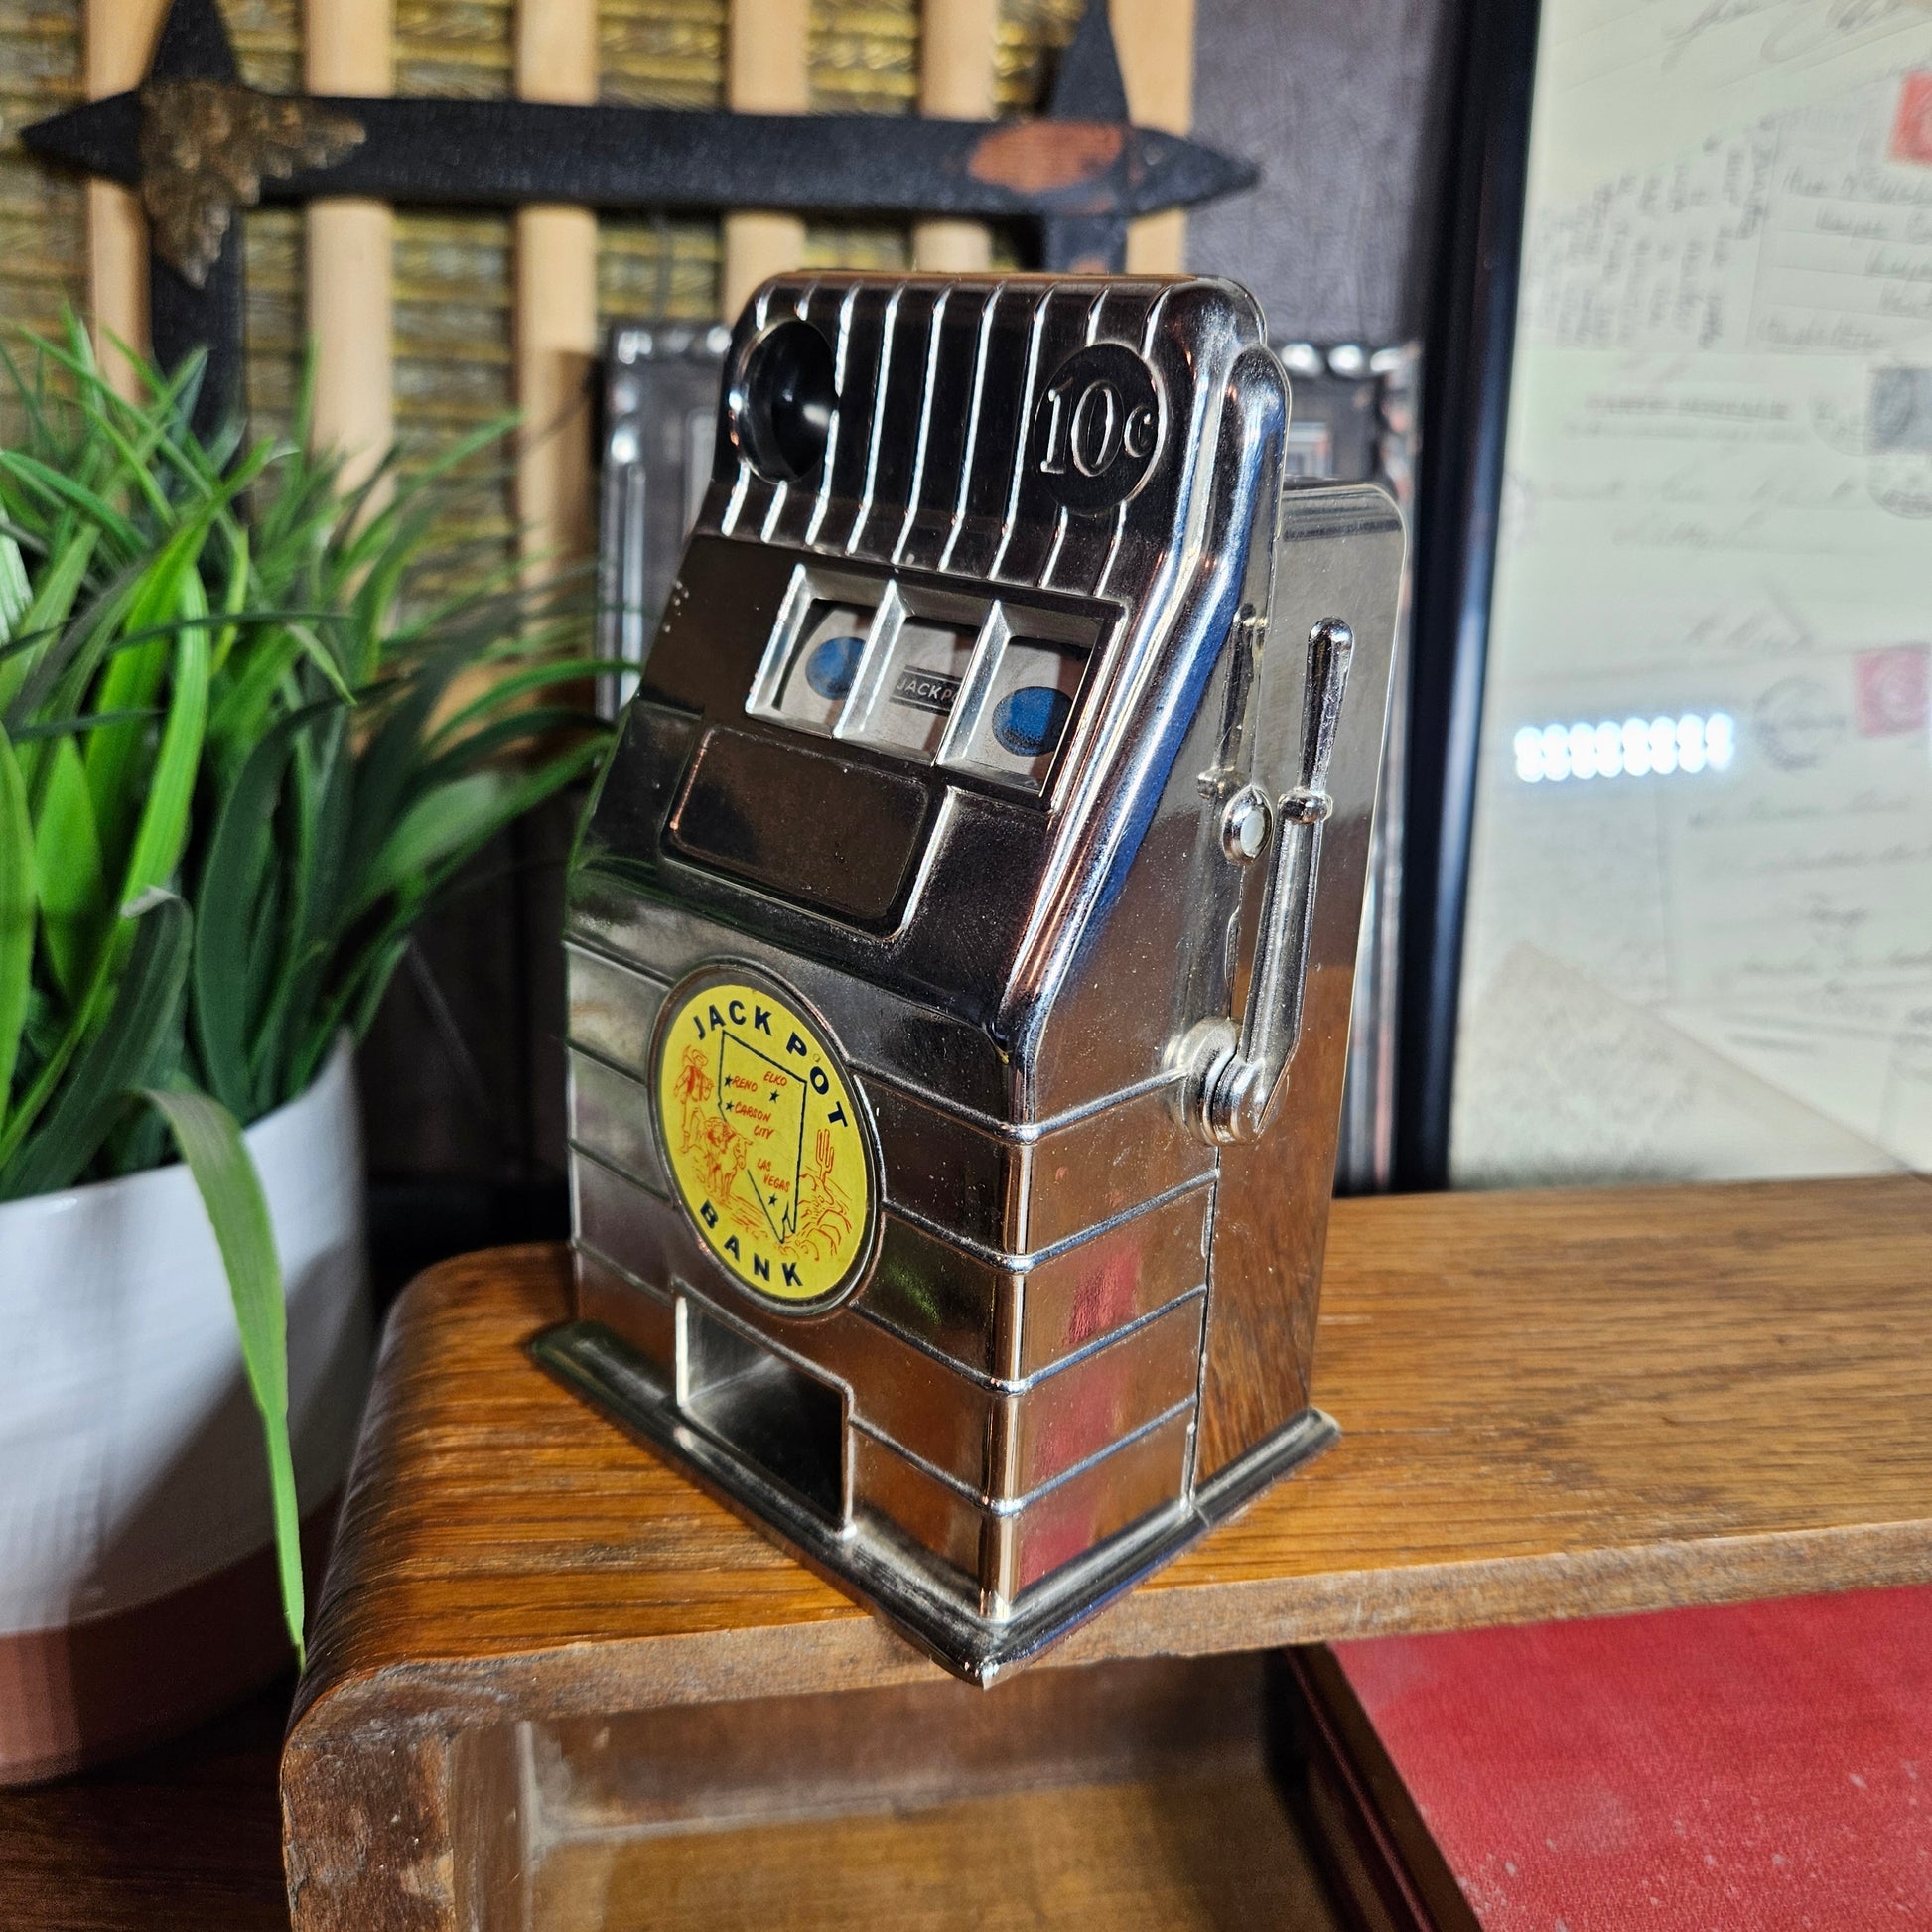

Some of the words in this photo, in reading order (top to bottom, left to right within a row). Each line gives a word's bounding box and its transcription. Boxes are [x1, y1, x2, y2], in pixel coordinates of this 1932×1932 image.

[897, 677, 957, 703] JACKP
[693, 1000, 772, 1040] JACK
[785, 1031, 848, 1128] POT
[733, 1075, 758, 1092] RENO
[763, 1071, 787, 1087] ELKO
[735, 1101, 771, 1122] CARSON
[753, 1125, 774, 1140] CITY
[758, 1158, 771, 1172] LAS
[763, 1173, 790, 1193] VEGAS
[700, 1199, 803, 1287] BANK
